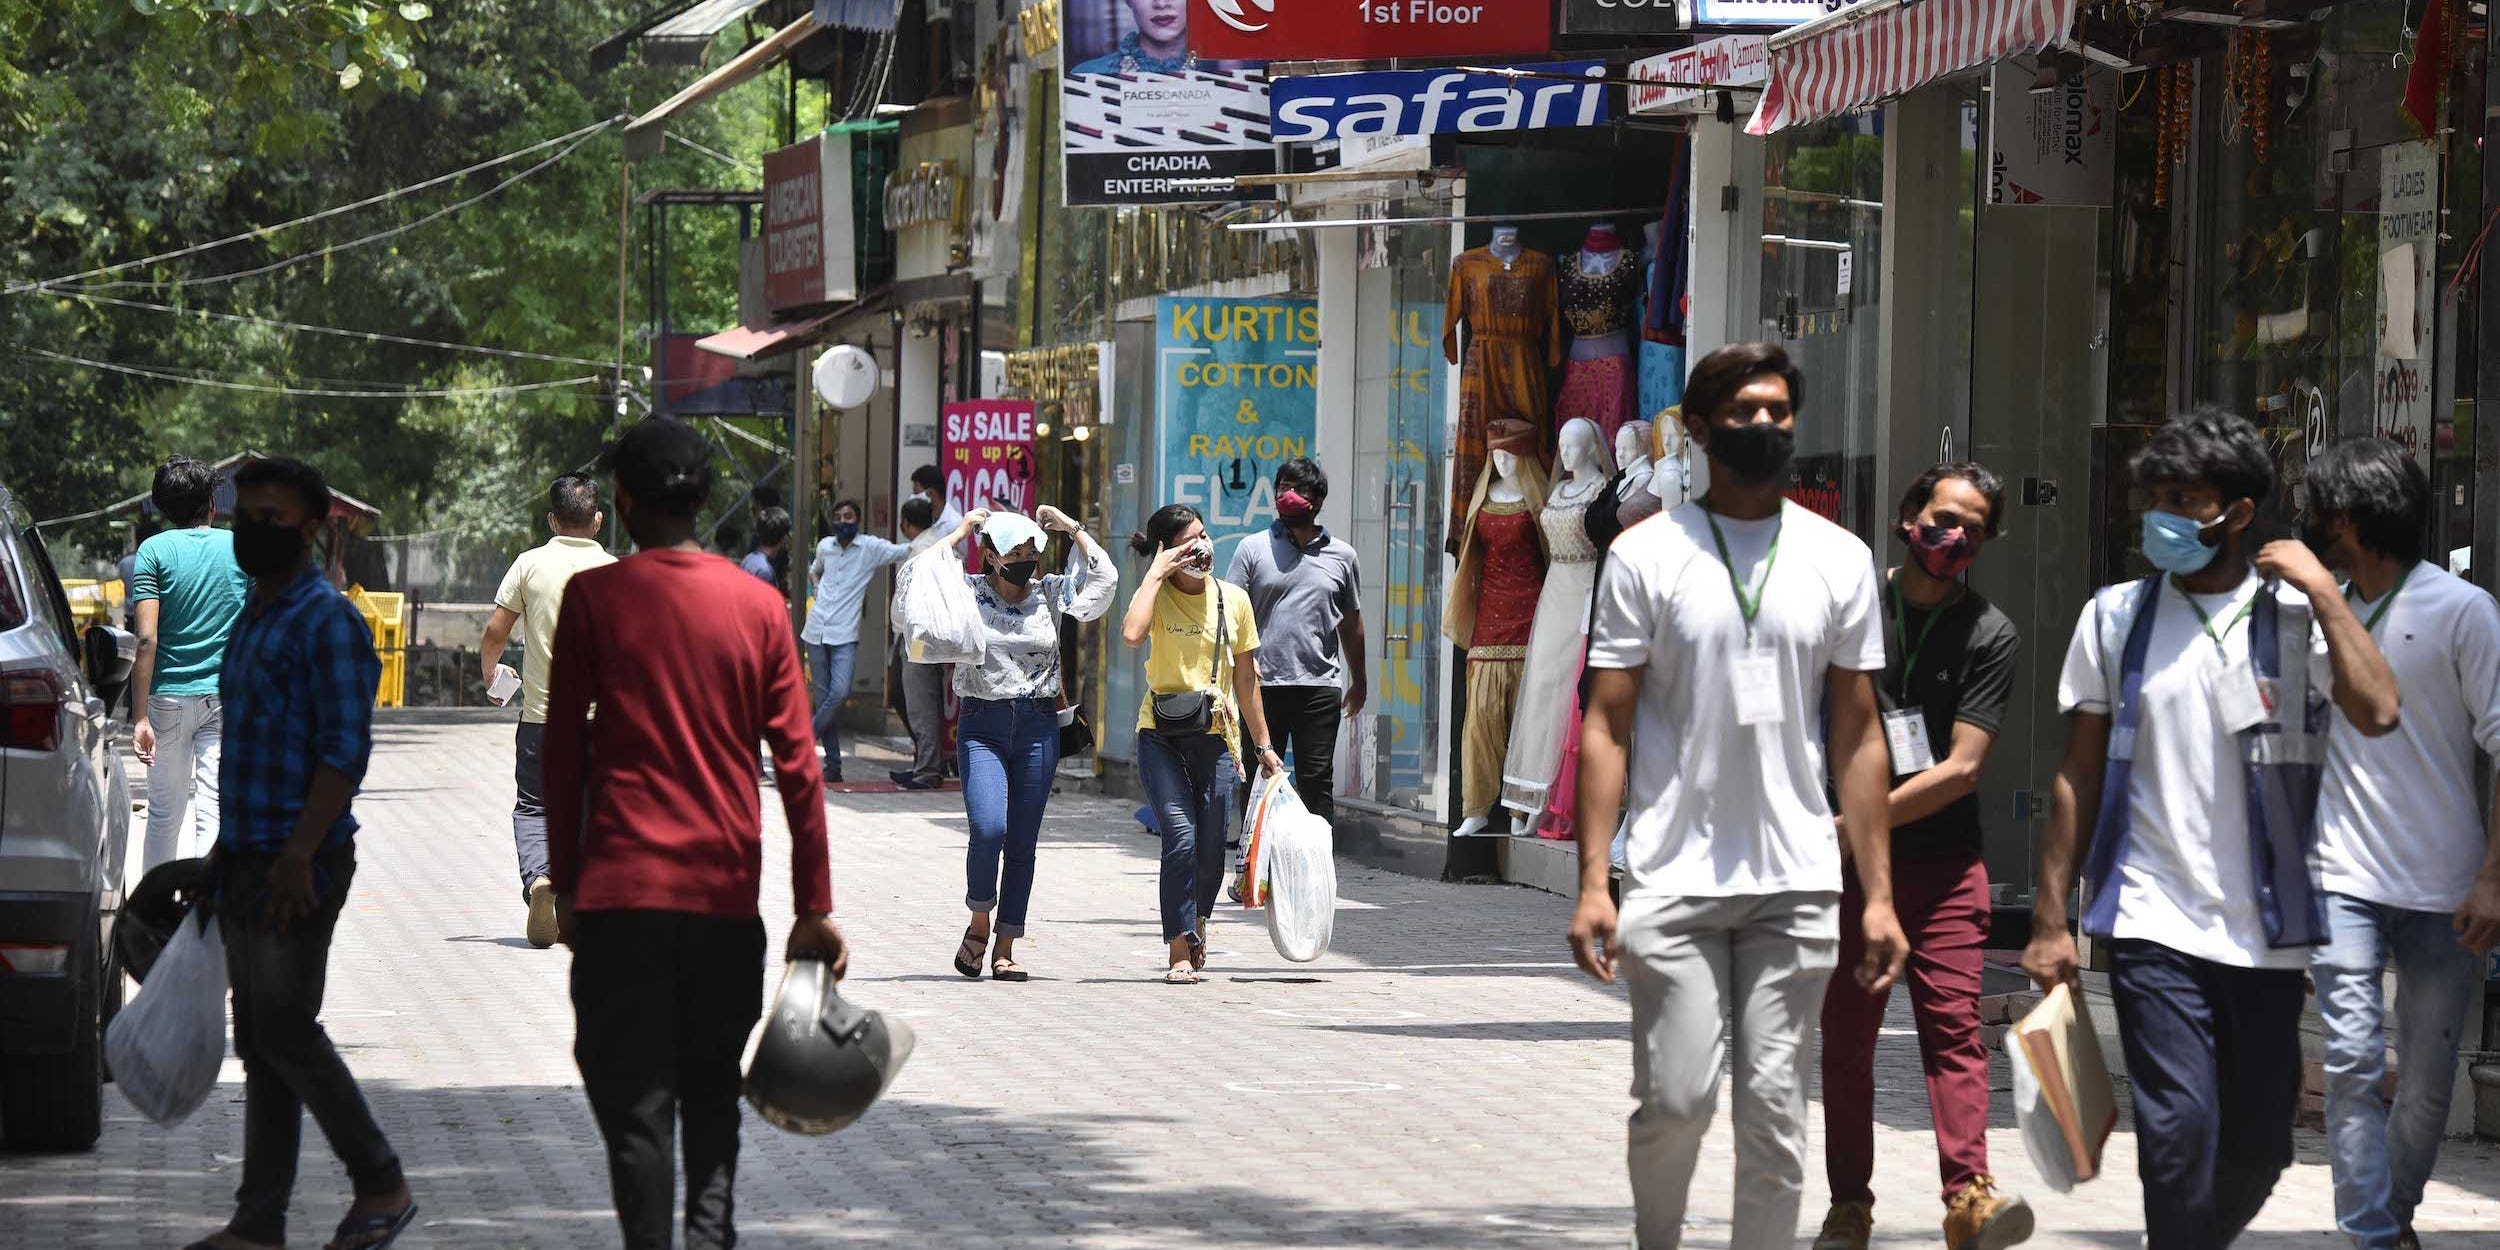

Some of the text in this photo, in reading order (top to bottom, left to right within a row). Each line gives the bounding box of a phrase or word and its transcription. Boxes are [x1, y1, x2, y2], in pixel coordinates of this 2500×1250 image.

[1358, 0, 1484, 24] 1st Floor
[1731, 38, 1763, 75] Campus
[1271, 65, 1606, 143] safari
[1127, 155, 1211, 172] CHADHA
[2392, 171, 2425, 199] LADIES
[2382, 209, 2433, 240] FOOTWEAR
[1172, 304, 1318, 343] KURTIS
[1177, 361, 1317, 389] COTTON
[1235, 398, 1260, 424] &
[973, 411, 1031, 441] SALE
[982, 443, 1022, 463] up to
[1188, 434, 1305, 460] RAYON
